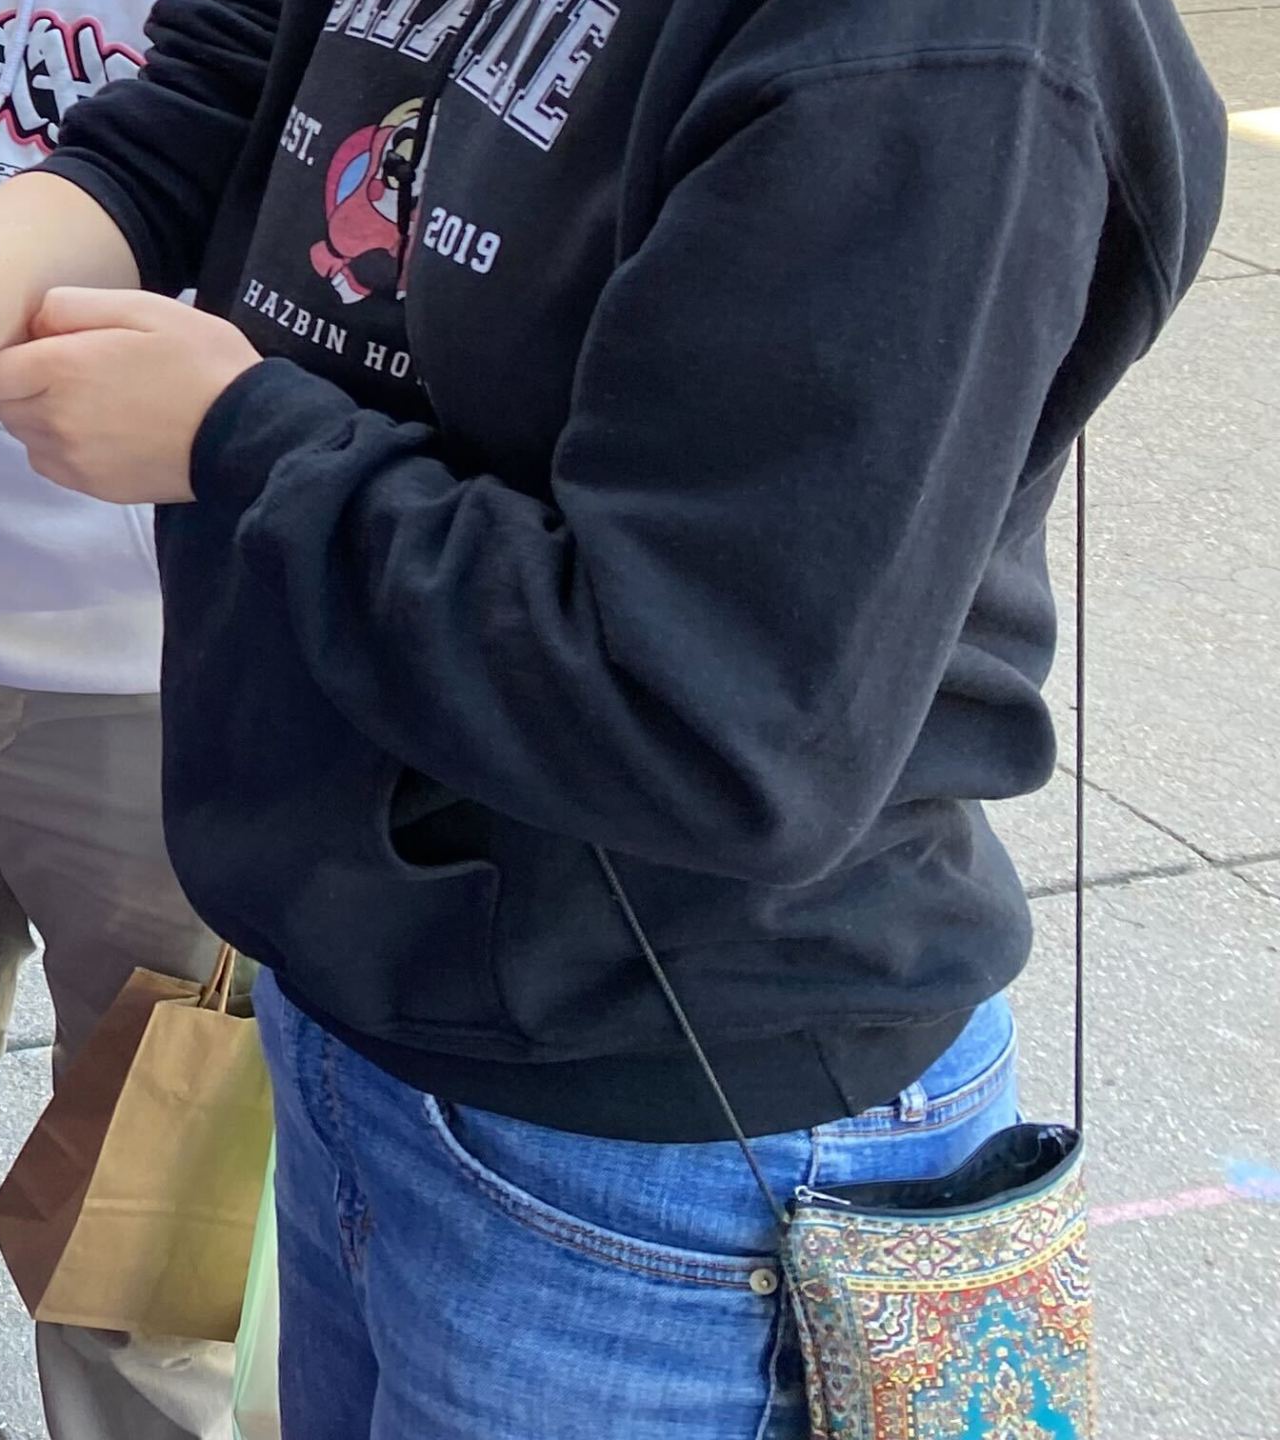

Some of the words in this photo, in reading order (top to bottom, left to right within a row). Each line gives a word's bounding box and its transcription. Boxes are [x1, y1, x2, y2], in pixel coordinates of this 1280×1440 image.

[422, 206, 502, 275] 2019
[242, 278, 349, 354] HAZBIN
[363, 341, 420, 383] HO
